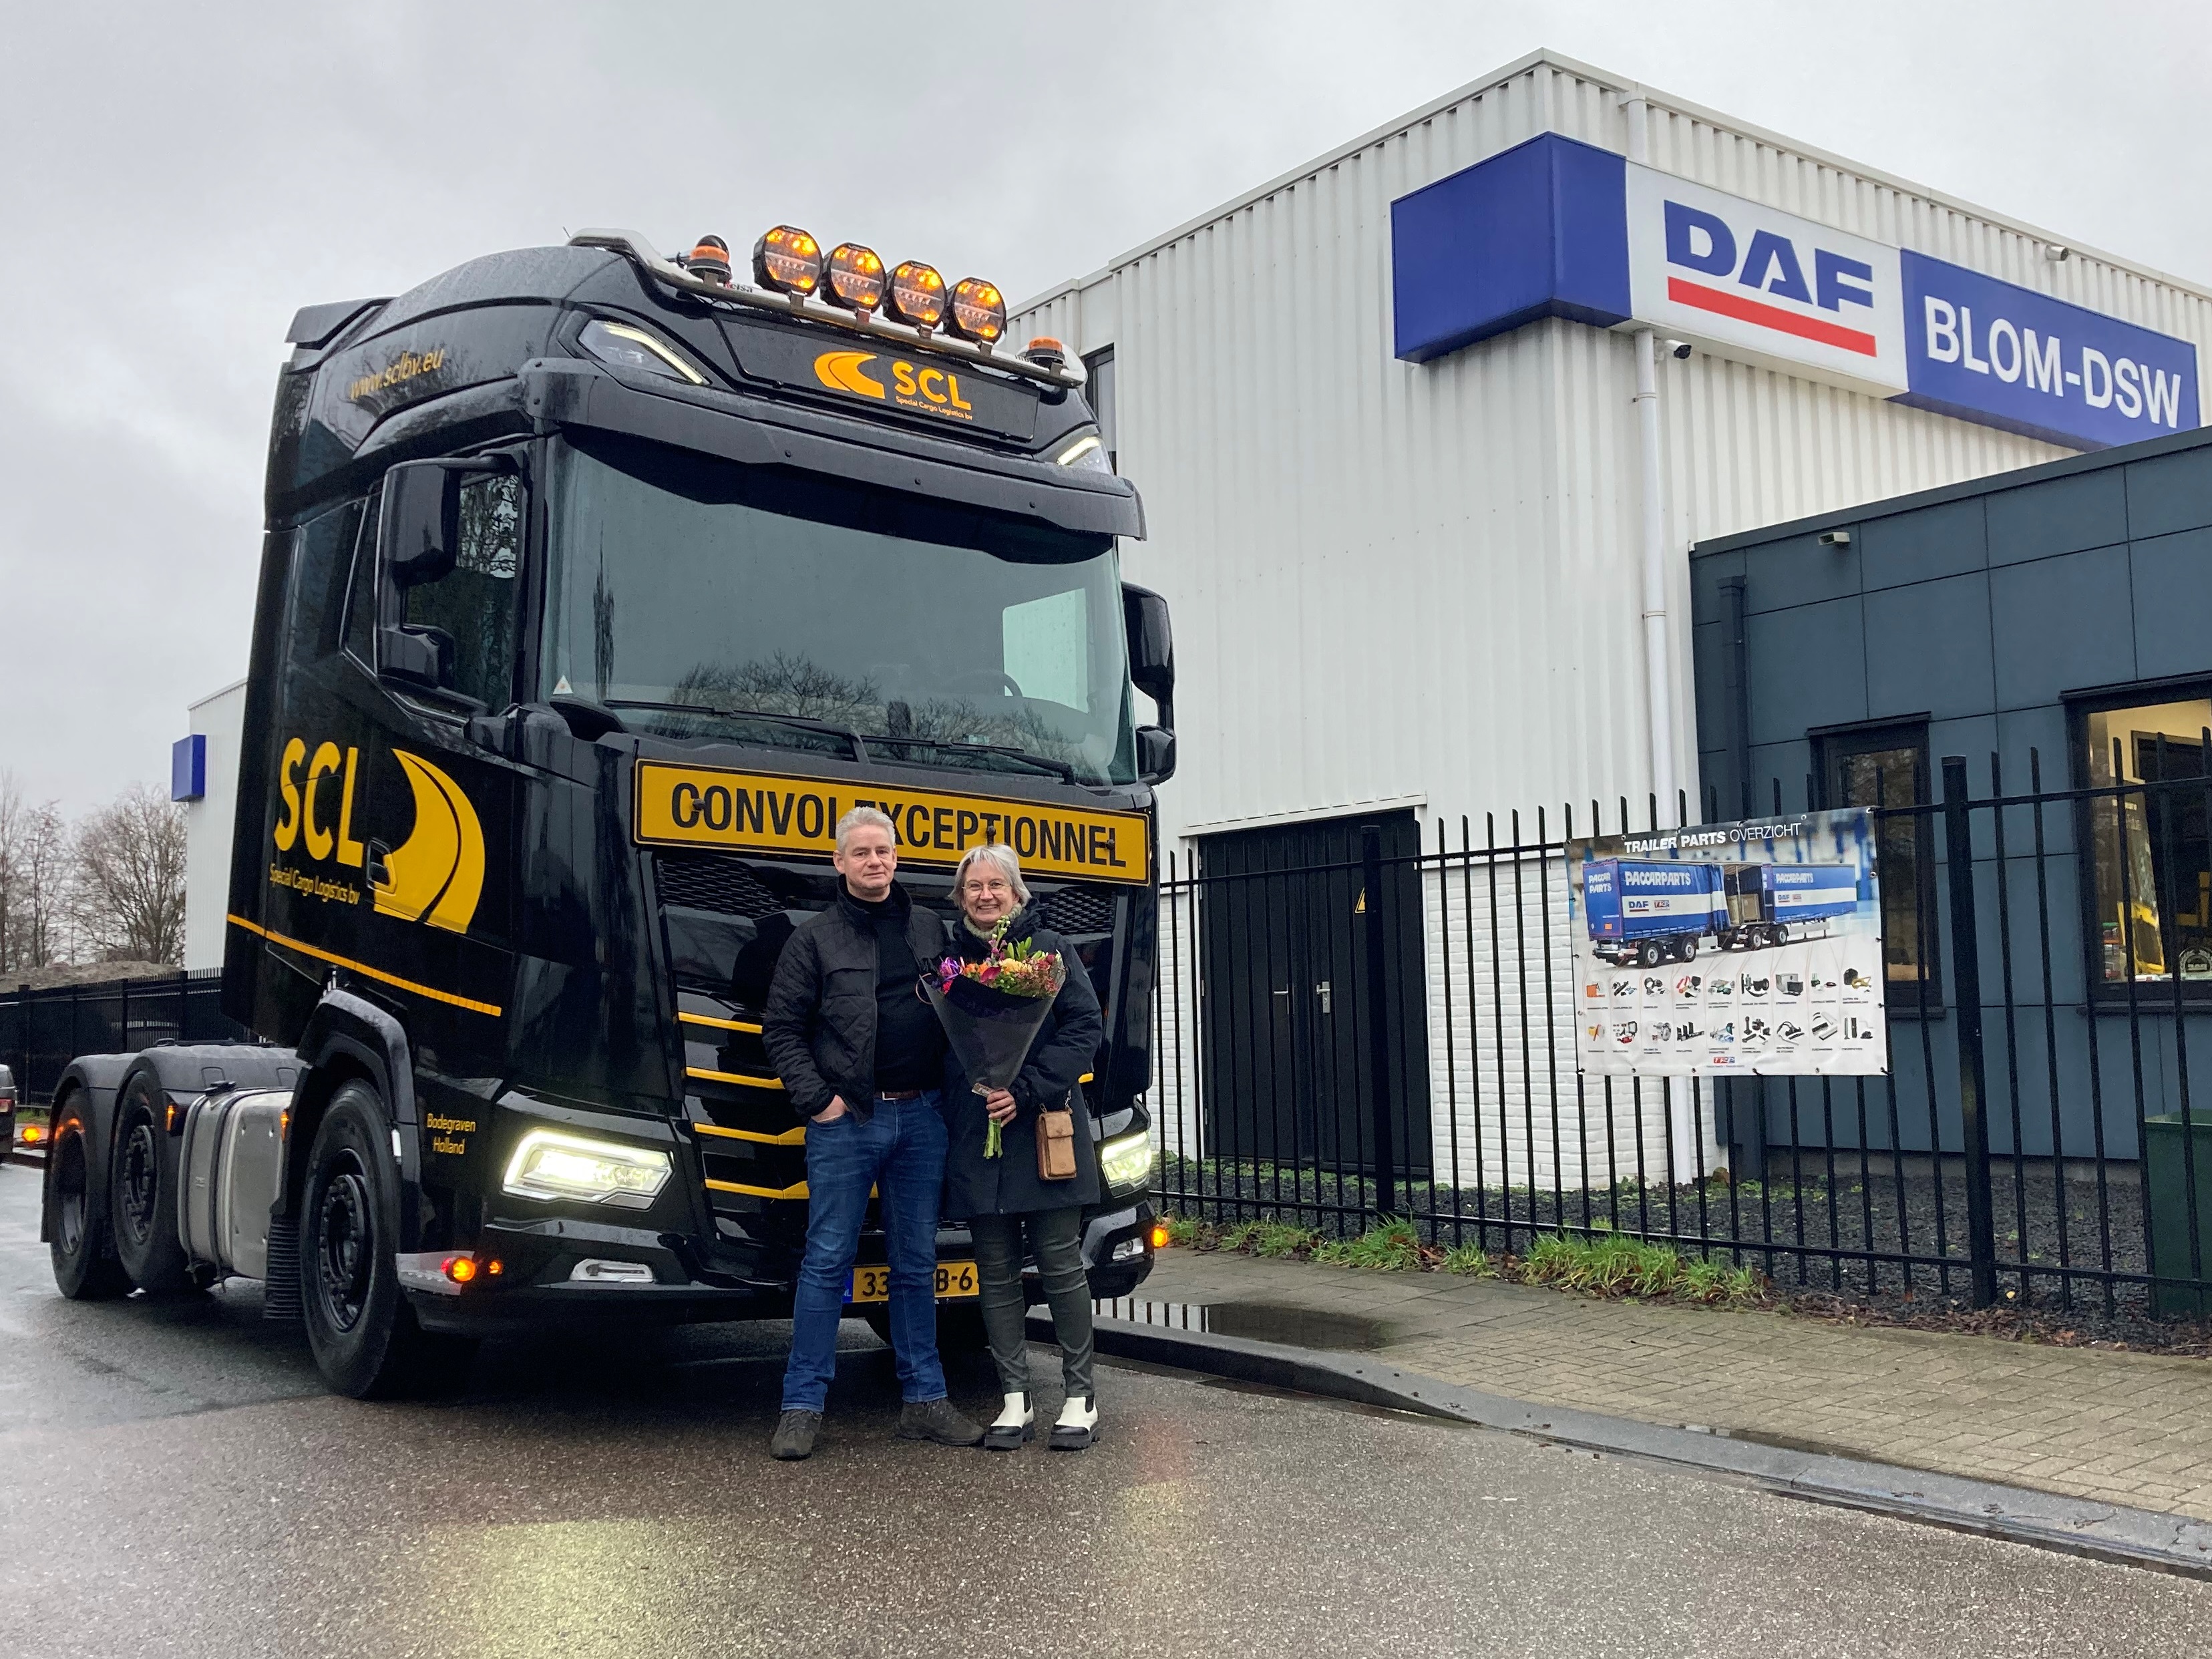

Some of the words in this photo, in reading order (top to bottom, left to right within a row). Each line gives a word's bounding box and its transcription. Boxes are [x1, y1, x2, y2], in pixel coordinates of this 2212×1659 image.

[1664, 199, 1874, 312] DAF
[350, 348, 444, 400] www.sclbv.eu
[1924, 295, 2182, 429] BLOM-DSW
[892, 360, 972, 410] SCL
[896, 396, 918, 406] Special
[918, 401, 938, 412] Cargo
[938, 406, 964, 418] Logistics
[274, 737, 364, 868] SCL
[671, 782, 837, 840] CONVOI
[854, 799, 1127, 868] XCEPTIONNEL
[1624, 836, 1677, 854] TRAILER
[1680, 831, 1726, 848] PARTS
[1729, 822, 1802, 843] OVERZICHT
[270, 863, 294, 888] Special
[293, 870, 314, 896] Cargo
[315, 875, 348, 902] Logistics
[1589, 883, 1612, 894] PARTS
[1628, 900, 1650, 909] DAF
[427, 1113, 476, 1135] Bodegraven
[433, 1136, 466, 1155] Holland
